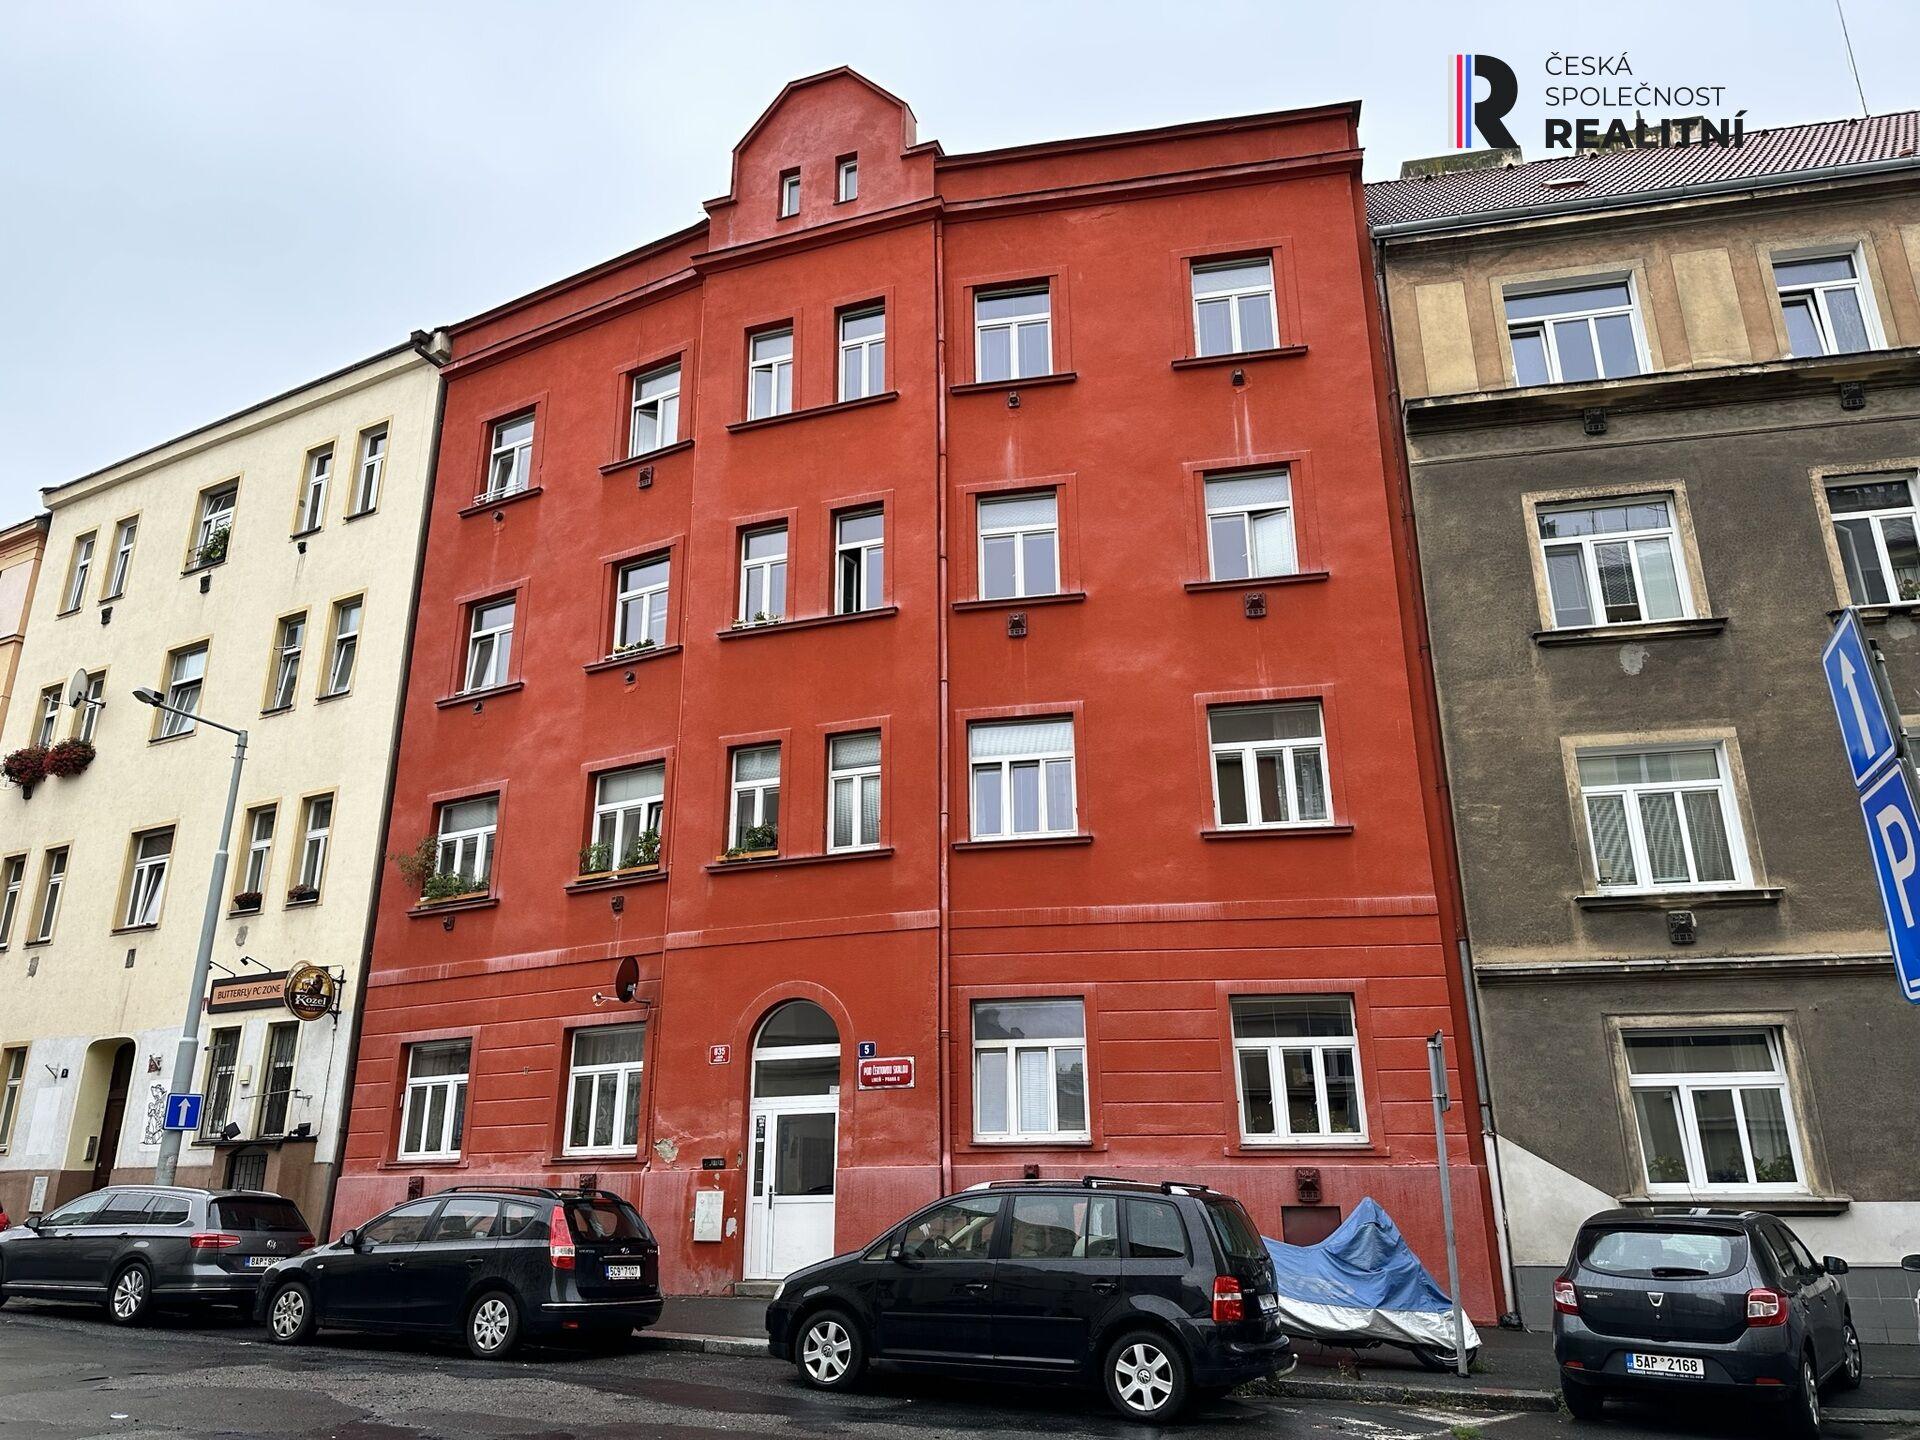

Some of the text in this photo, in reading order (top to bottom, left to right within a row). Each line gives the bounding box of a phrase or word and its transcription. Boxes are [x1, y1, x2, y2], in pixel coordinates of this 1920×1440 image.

[1876, 804, 1915, 928] P
[217, 984, 281, 999] BUTTERFLY PC ZONE
[295, 994, 326, 1006] Kozel
[714, 1047, 725, 1055] 835
[864, 1045, 870, 1054] 5
[1635, 1355, 1698, 1373] 5AP 2168
